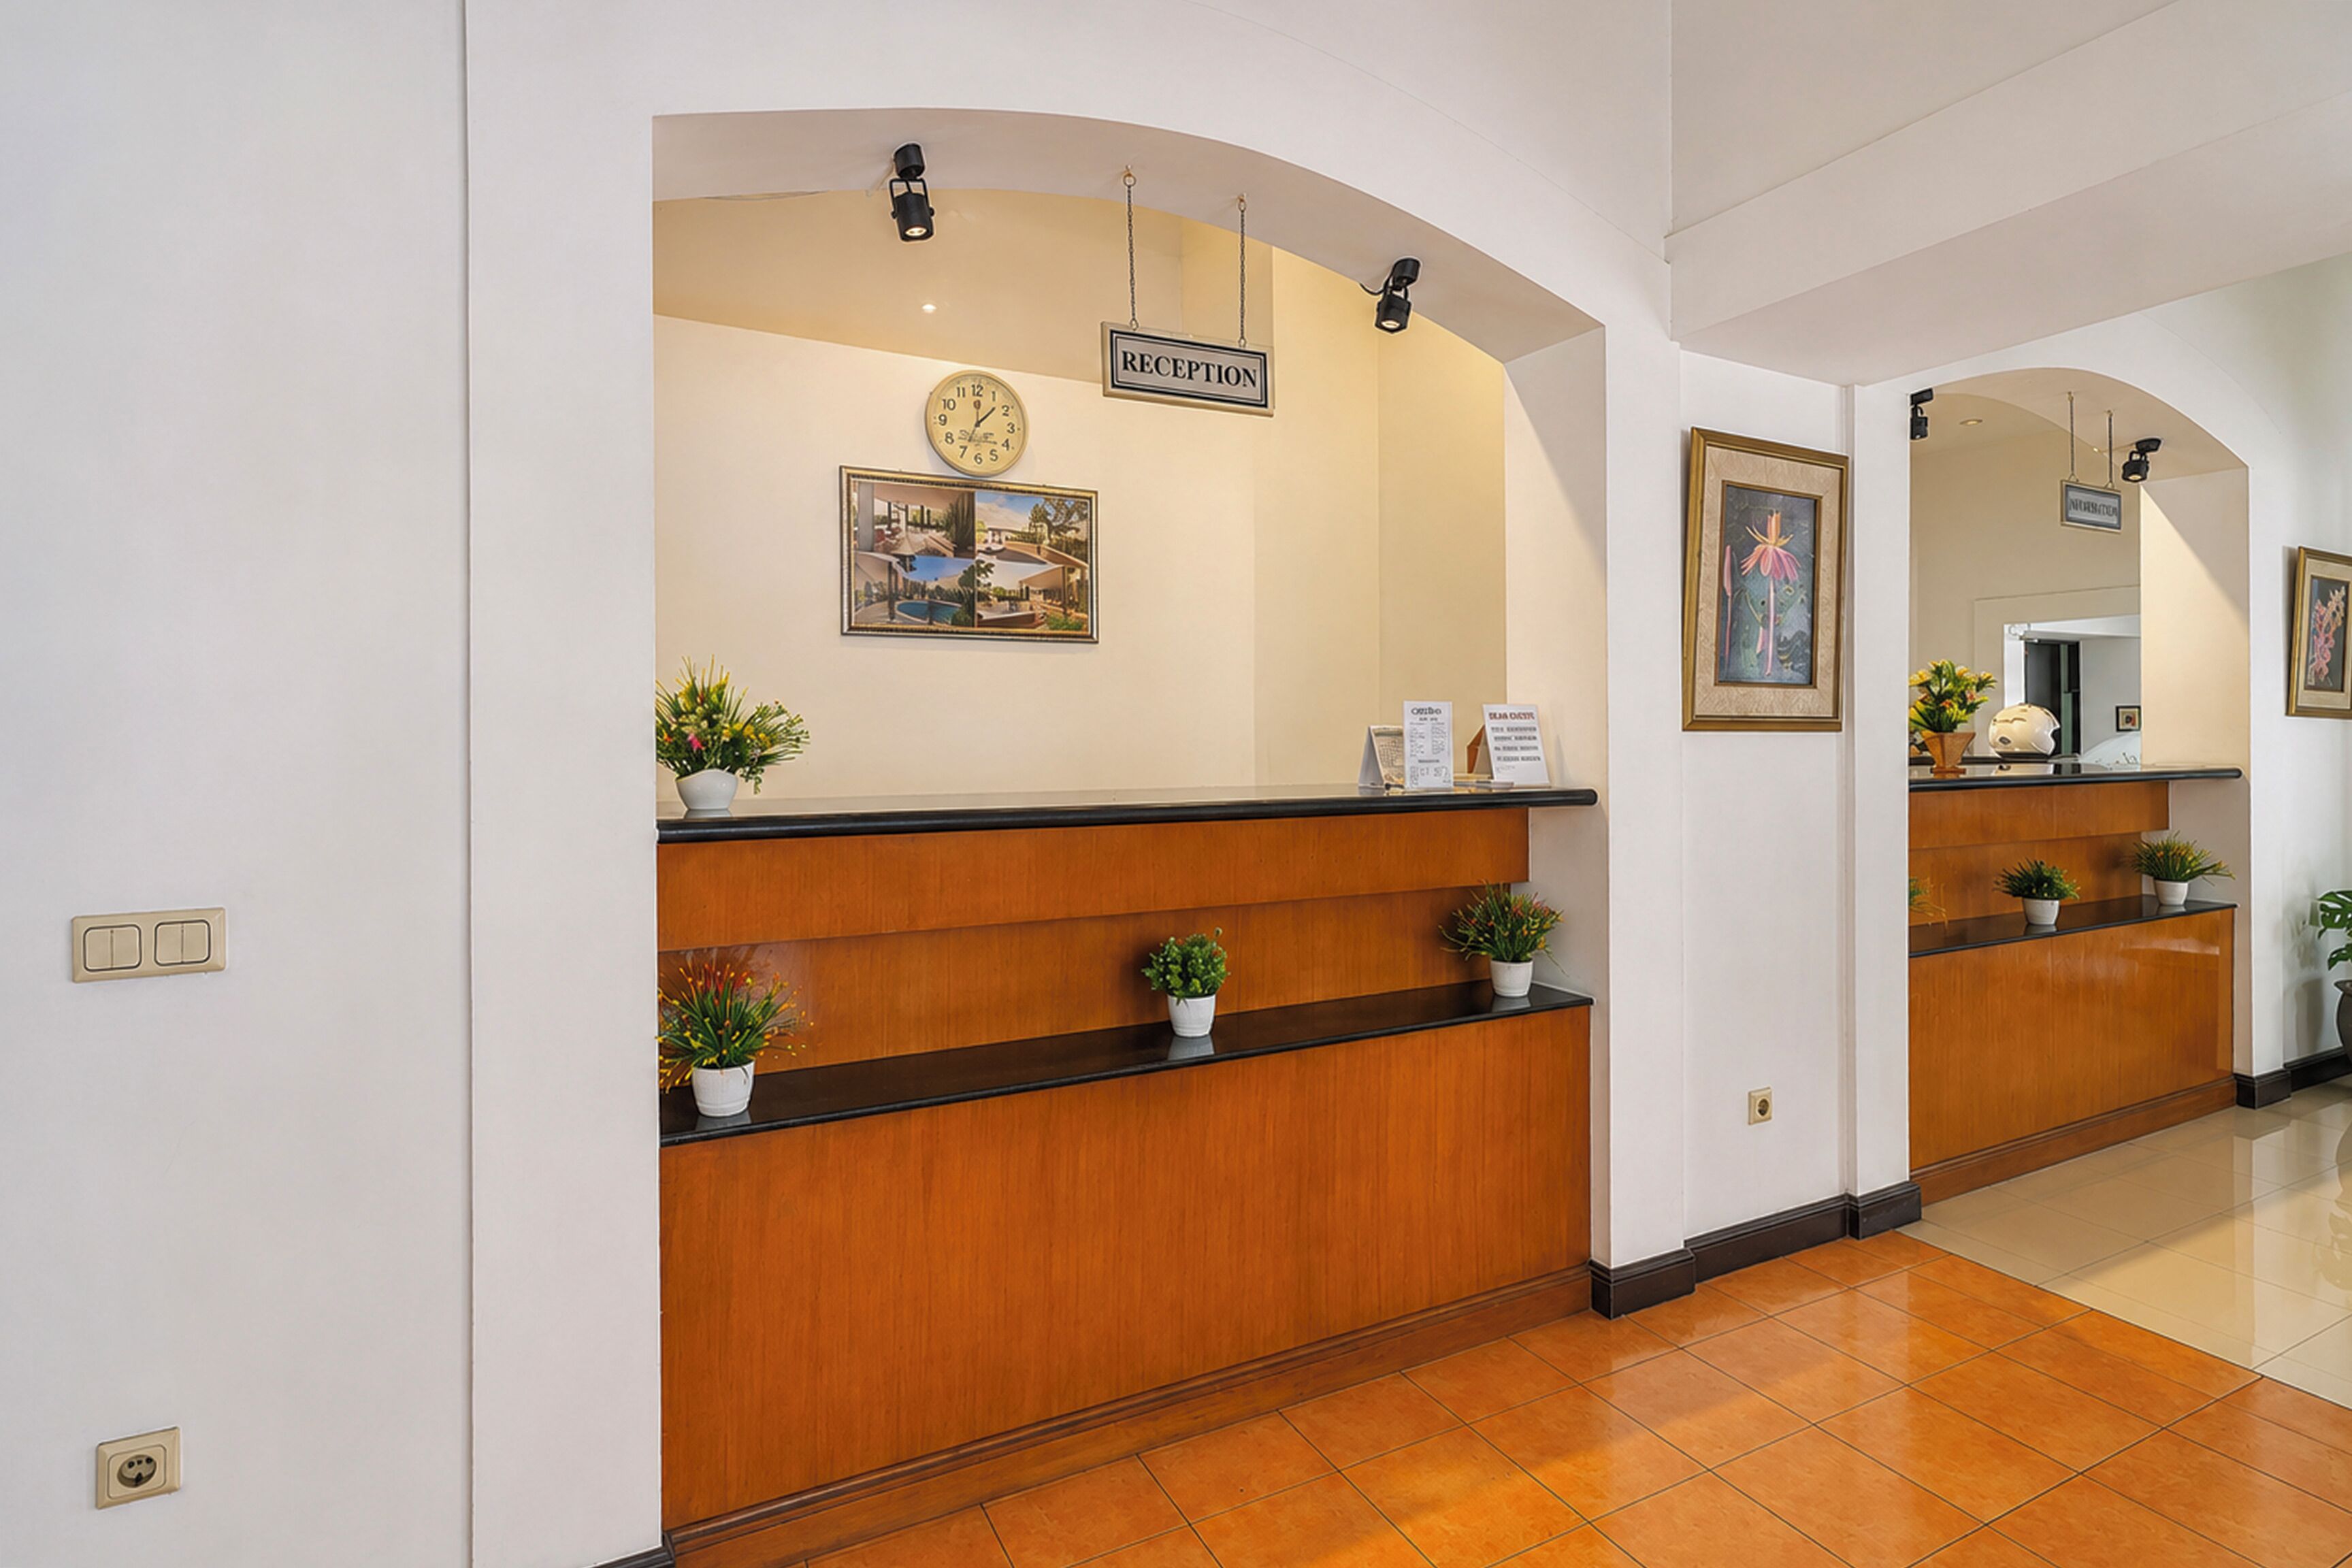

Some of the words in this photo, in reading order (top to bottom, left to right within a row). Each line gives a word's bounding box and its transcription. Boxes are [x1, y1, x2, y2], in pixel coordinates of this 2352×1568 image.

[1122, 350, 1257, 388] RECEPTION
[957, 387, 966, 397] 11
[971, 384, 983, 397] 12
[942, 398, 956, 410] 10
[1001, 405, 1010, 416] 2
[938, 414, 947, 425] 9
[1007, 422, 1015, 434] 3
[945, 432, 954, 444] 8
[1001, 438, 1010, 451] 4
[959, 446, 968, 458] 7
[989, 449, 998, 461] 5
[974, 453, 983, 465] 6
